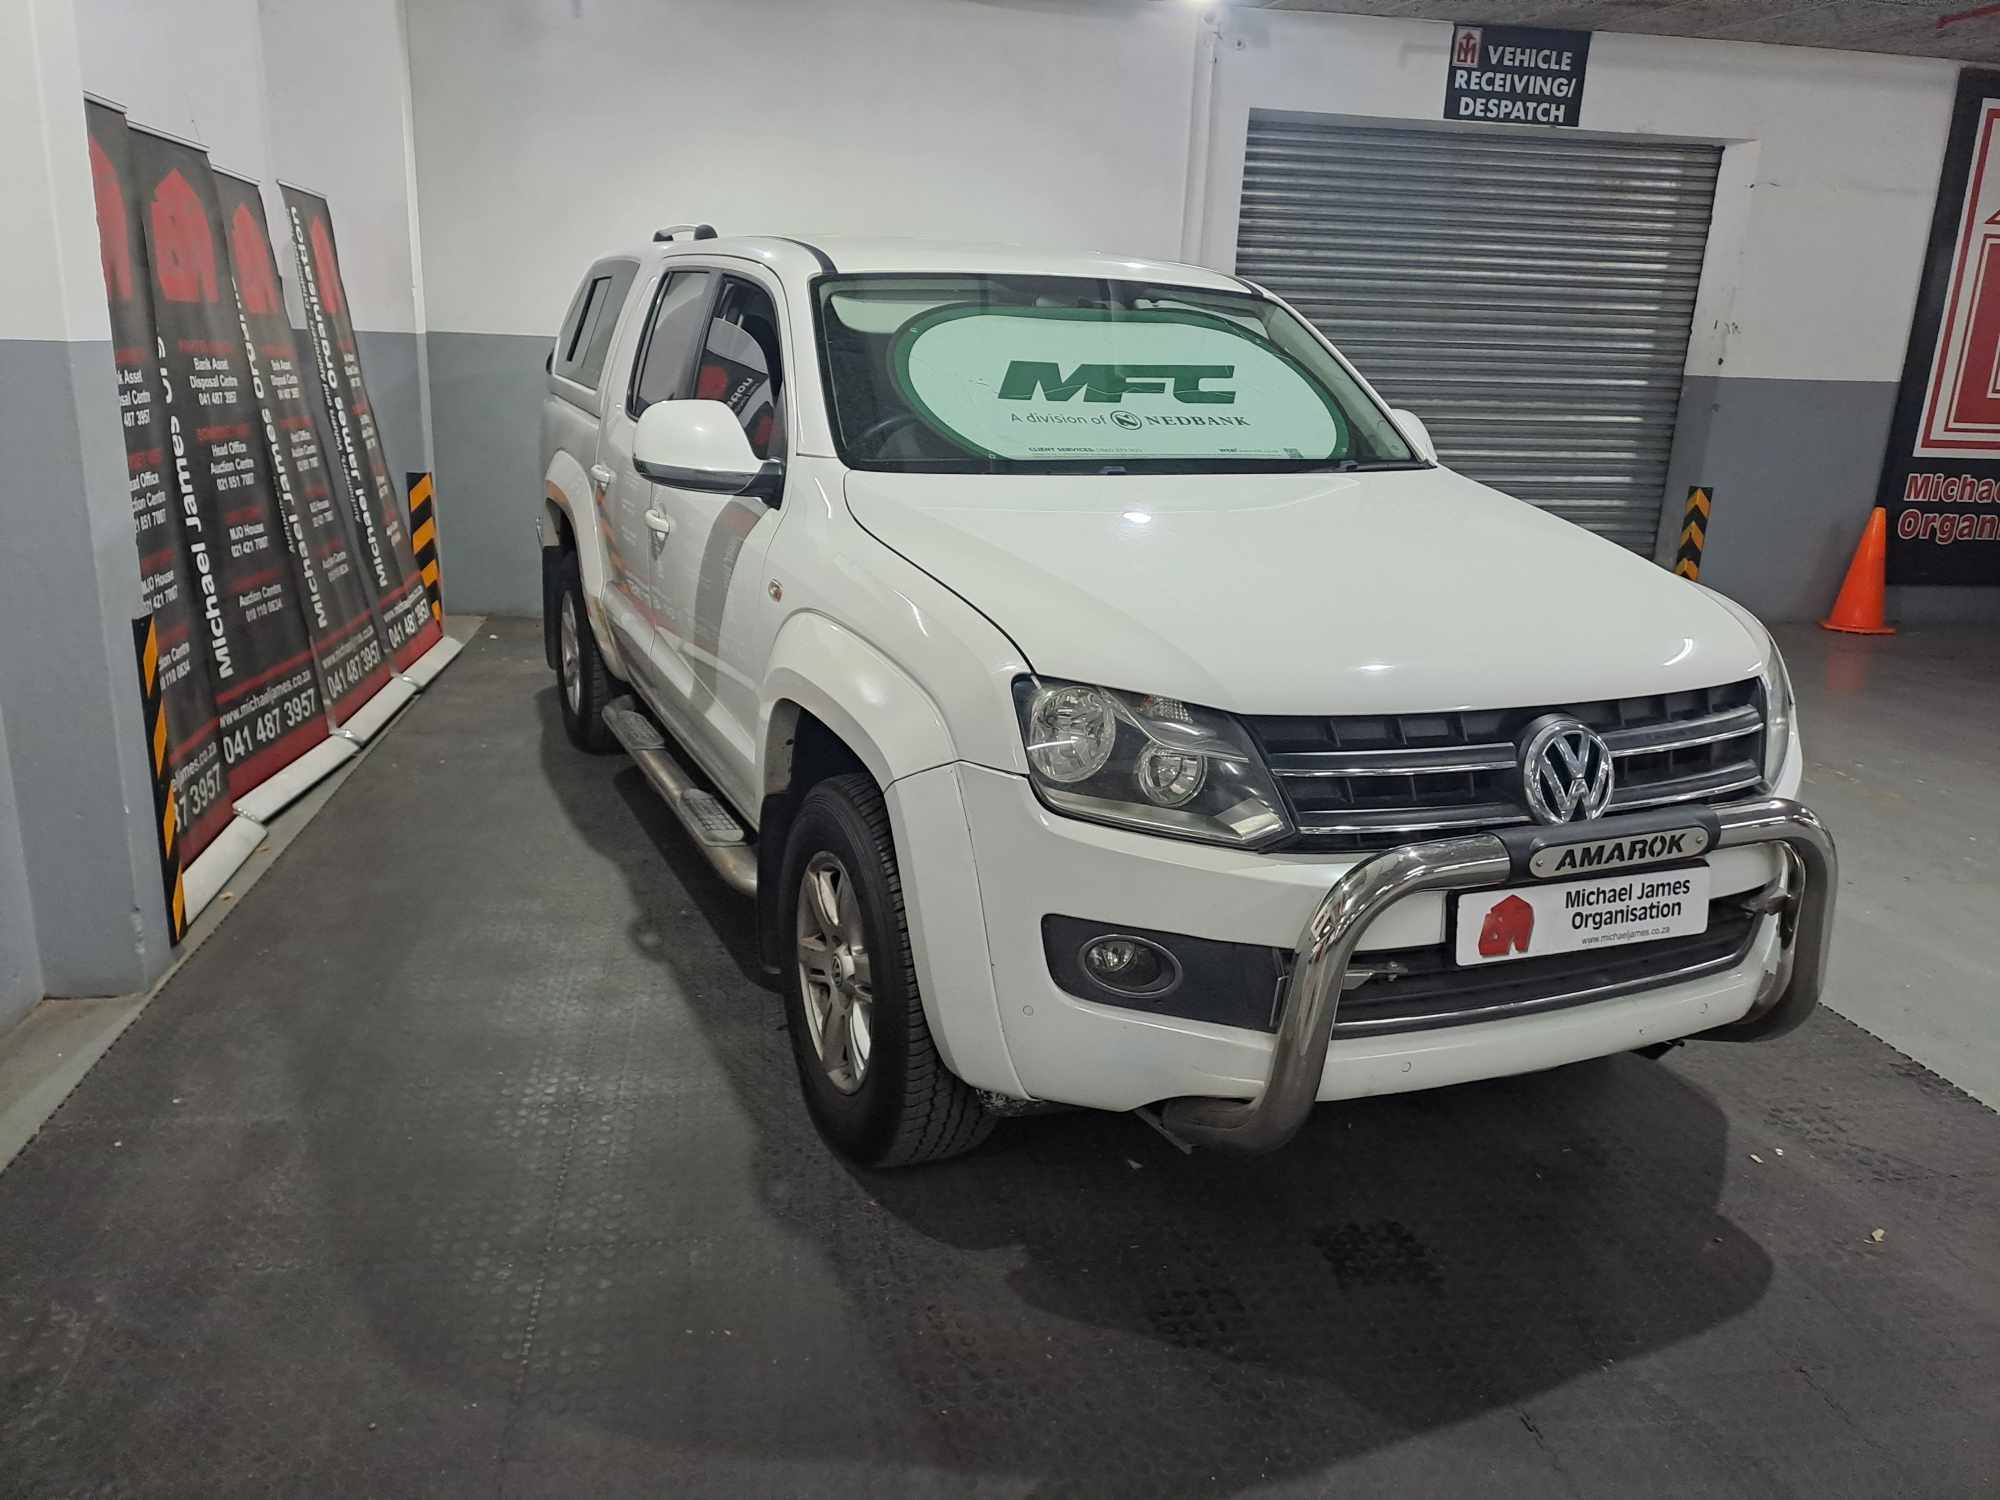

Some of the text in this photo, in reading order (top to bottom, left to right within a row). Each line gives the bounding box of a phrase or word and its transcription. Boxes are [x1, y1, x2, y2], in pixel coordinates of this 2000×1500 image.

[1487, 45, 1574, 71] VEHICLE
[1454, 69, 1577, 98] RECEIVING/
[1458, 96, 1566, 123] DESPATCH
[291, 206, 338, 389] Organisation
[998, 360, 1236, 404] MFC
[335, 396, 360, 480] James
[1011, 413, 1023, 422] A
[1026, 412, 1088, 424] division
[1090, 414, 1107, 424] of
[1144, 415, 1252, 427] NEDBANK
[262, 408, 295, 506] James
[355, 488, 388, 587] Michael
[1898, 509, 2000, 545] Organ
[154, 570, 174, 589] House
[288, 514, 328, 628] Michael
[190, 542, 234, 679] Michael
[388, 622, 405, 648] 041
[327, 640, 381, 699] 041 487 3957
[223, 688, 316, 765] 041 487 3957
[190, 762, 221, 815] 3957
[1555, 833, 1688, 872] AMAROK
[1565, 879, 1691, 909] Michael James
[1571, 901, 1682, 930] Organisation
